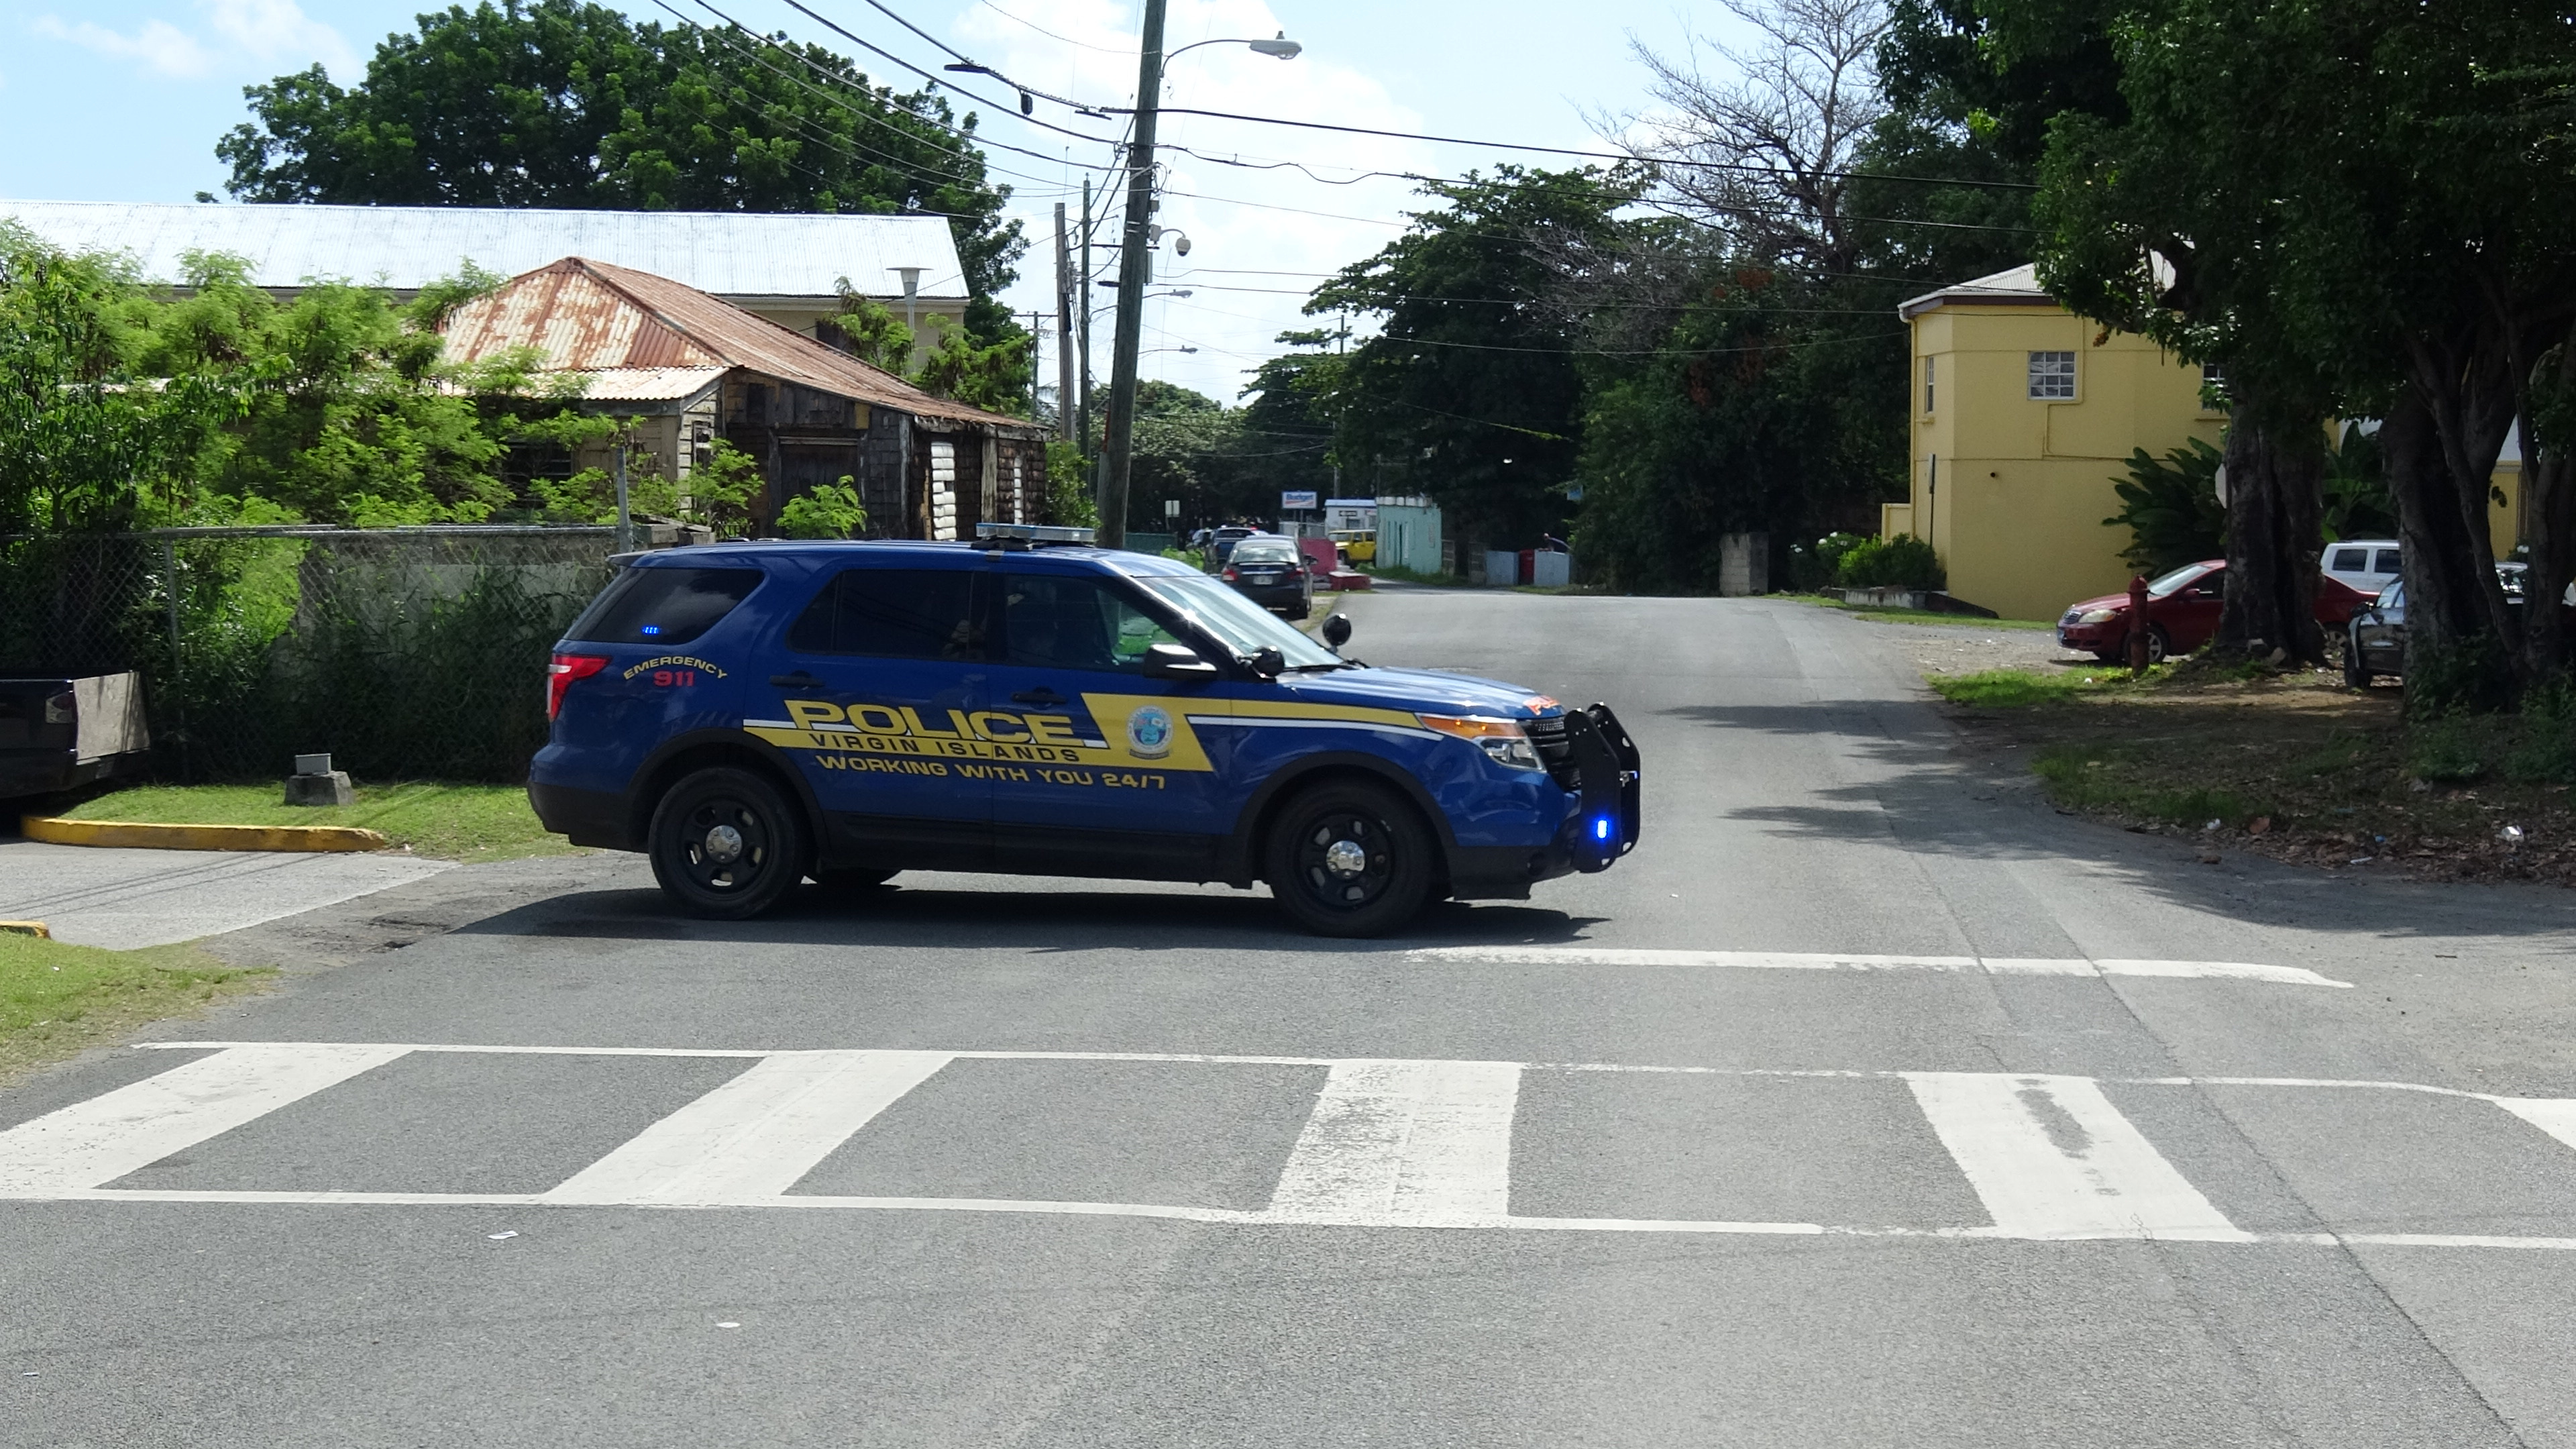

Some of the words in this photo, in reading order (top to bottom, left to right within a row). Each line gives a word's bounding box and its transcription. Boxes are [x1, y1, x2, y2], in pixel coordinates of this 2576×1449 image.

[1286, 494, 1313, 502] Budget
[623, 656, 728, 680] EMERGENCY
[653, 671, 694, 686] 911
[784, 700, 1085, 747] POLICE
[809, 733, 920, 752] VIRGIN
[936, 741, 1079, 761] ISLANDS
[816, 755, 948, 776] WORKING
[955, 763, 1030, 782] WITH
[1035, 769, 1094, 786] YOU
[1102, 773, 1165, 790] 24/7
